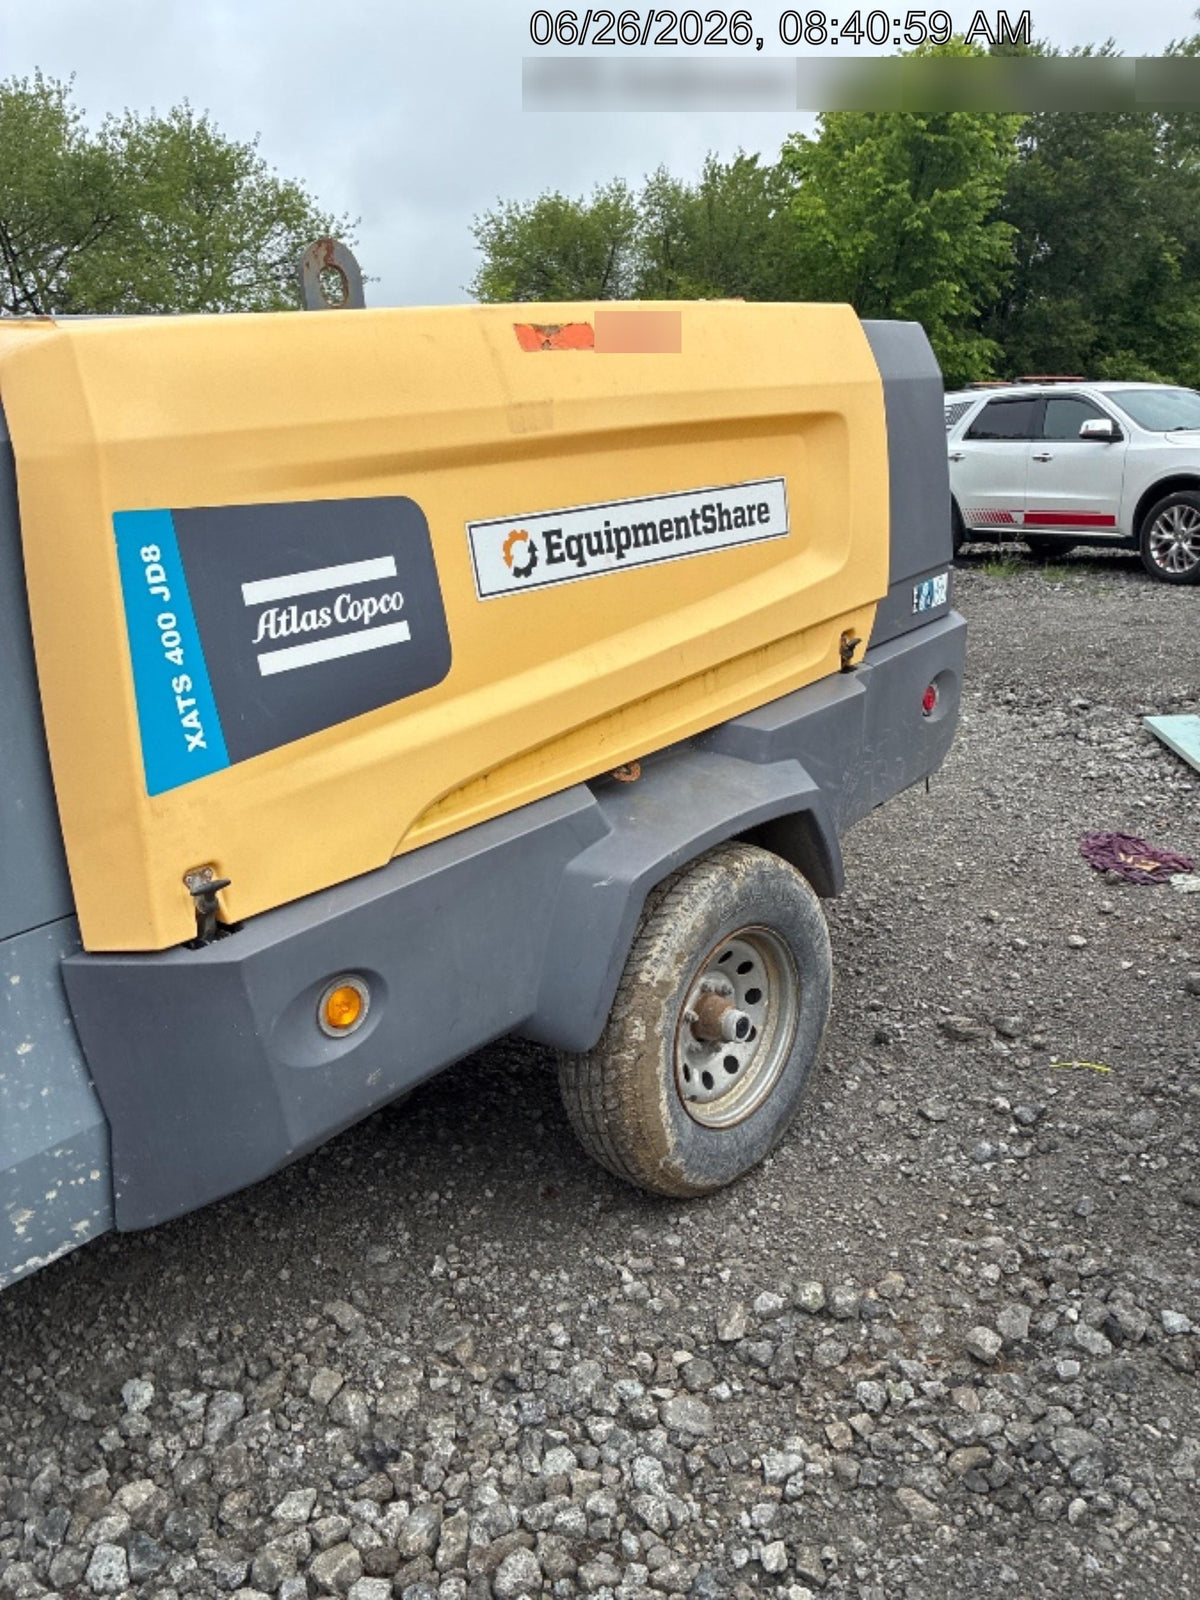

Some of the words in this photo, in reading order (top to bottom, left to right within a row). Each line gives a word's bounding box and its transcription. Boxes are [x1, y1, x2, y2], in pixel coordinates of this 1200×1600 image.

[542, 502, 771, 568] EquipmentShare
[140, 544, 171, 601] JD8
[157, 612, 184, 665] 400
[252, 606, 332, 644] Atlas
[334, 591, 404, 625] Copco
[172, 674, 207, 752] XATS
